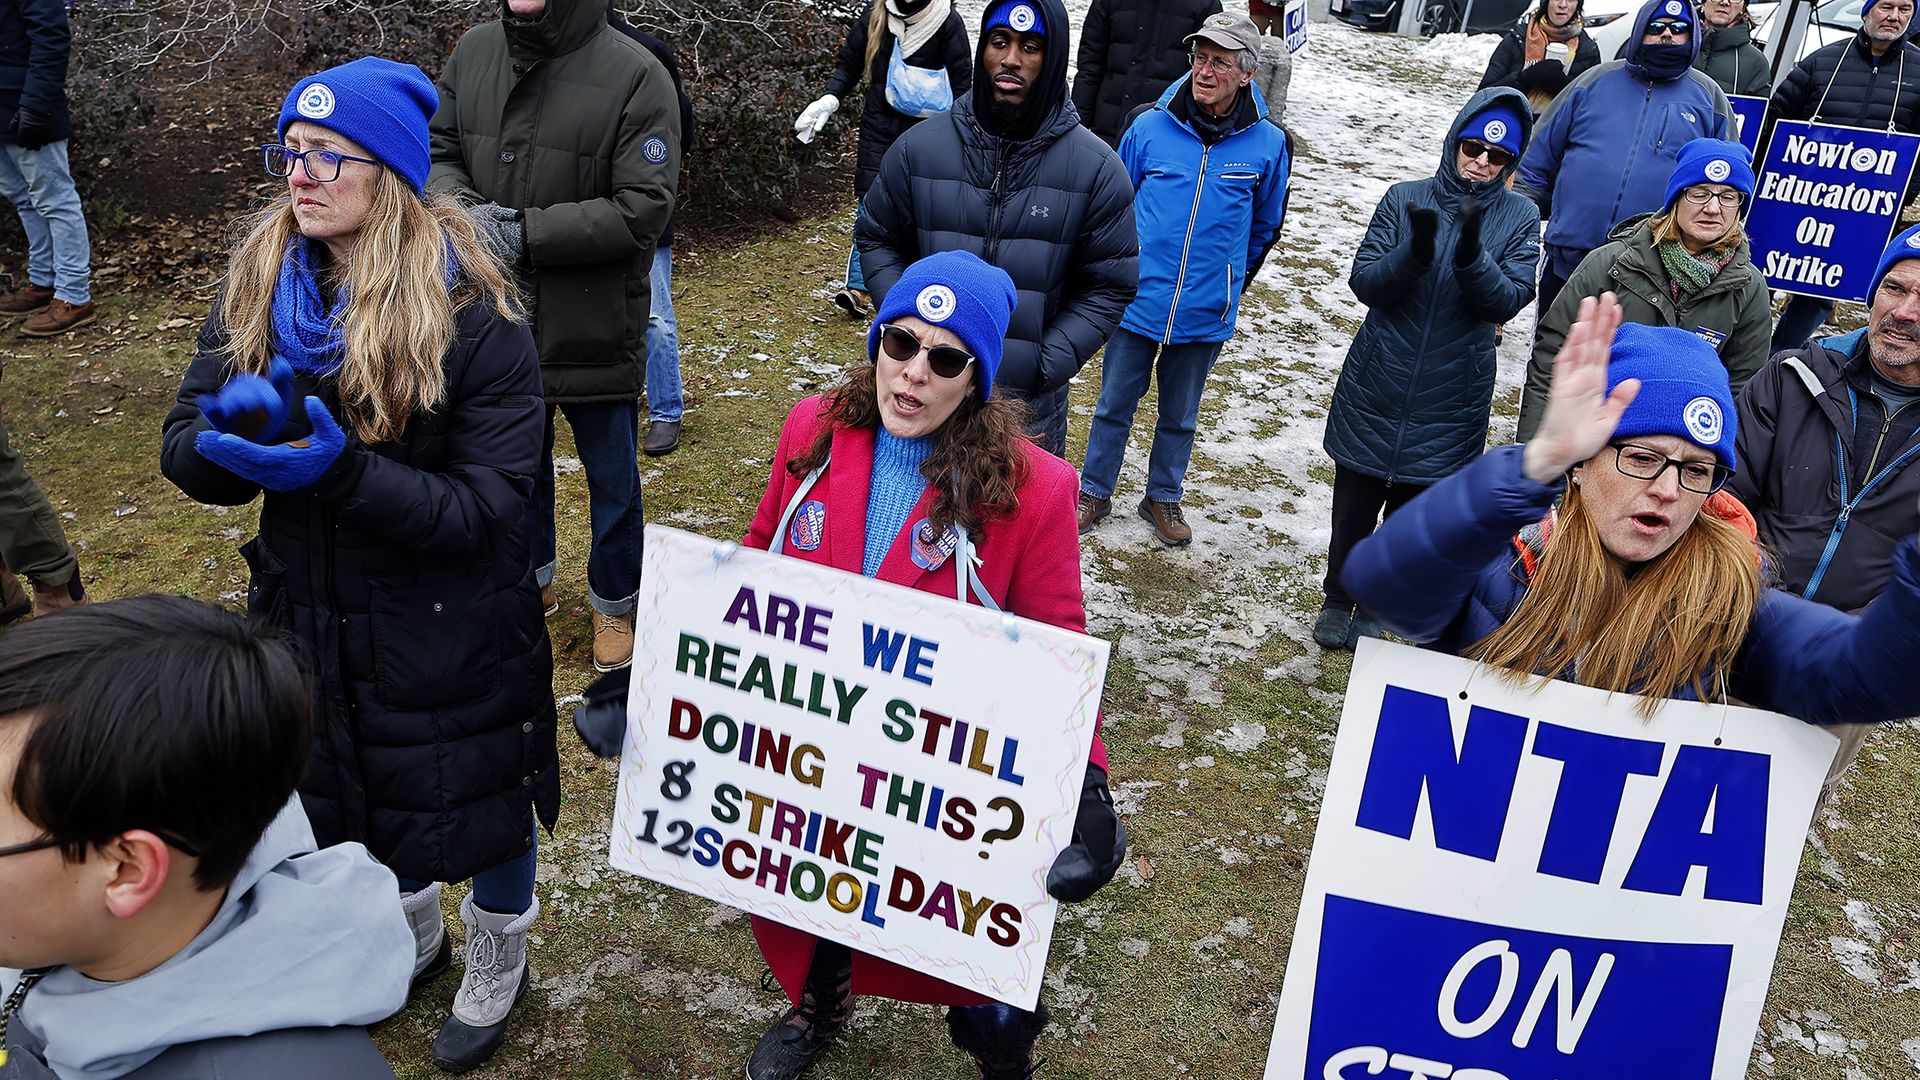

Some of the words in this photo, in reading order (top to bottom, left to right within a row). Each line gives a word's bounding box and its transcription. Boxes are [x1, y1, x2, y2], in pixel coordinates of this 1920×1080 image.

[1758, 171, 1897, 216] Educators
[1781, 134, 1898, 176] Newton
[1763, 250, 1843, 288] Strike
[1796, 216, 1835, 248] On
[800, 513, 813, 546] NOW
[723, 586, 834, 653] ARE
[862, 622, 939, 687] WE
[675, 632, 868, 725] REALLY
[881, 698, 1025, 787] STILL
[659, 760, 696, 802] 8
[710, 783, 885, 877] STRIKE
[667, 697, 826, 789] DOING
[856, 763, 1025, 860] THIS?
[1355, 684, 1771, 905] NTA
[886, 865, 1022, 948] DAYS
[1437, 939, 1616, 1055] ON
